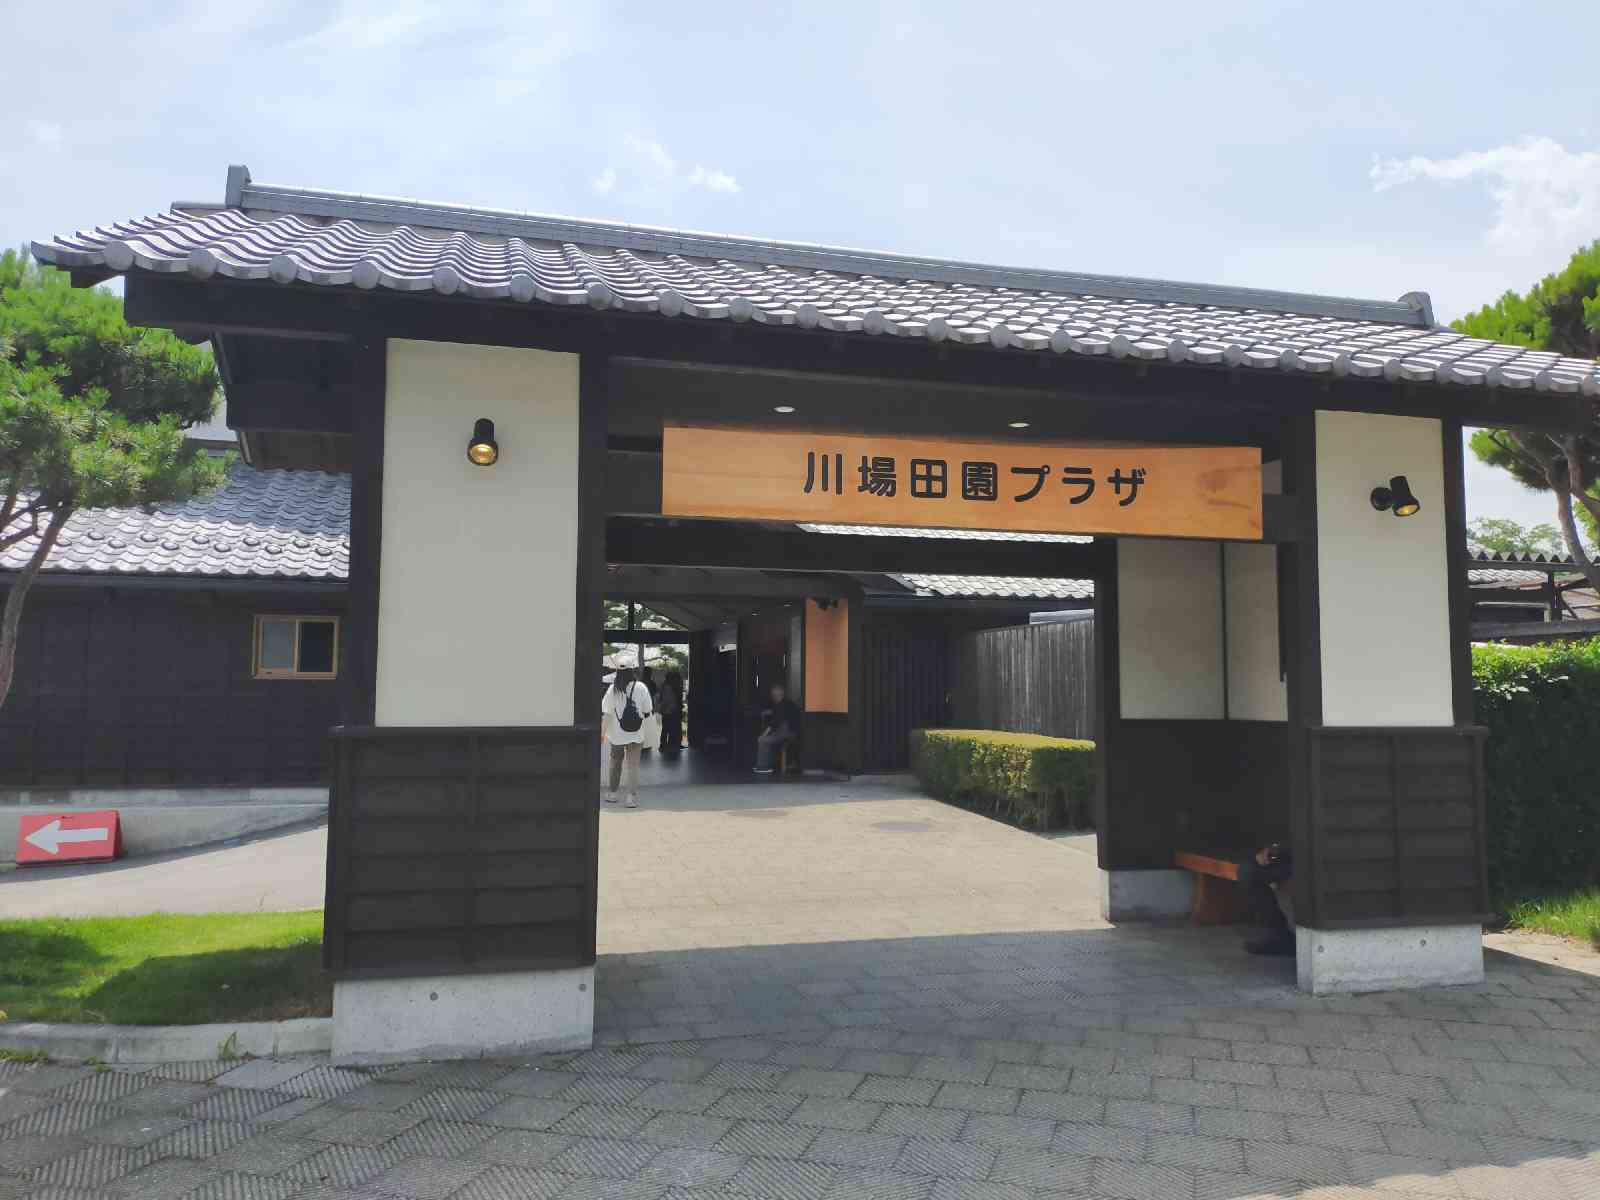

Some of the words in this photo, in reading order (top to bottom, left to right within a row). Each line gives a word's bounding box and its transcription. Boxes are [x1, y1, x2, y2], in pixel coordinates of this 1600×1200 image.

[803, 451, 1147, 507] 川場田園プラザ
